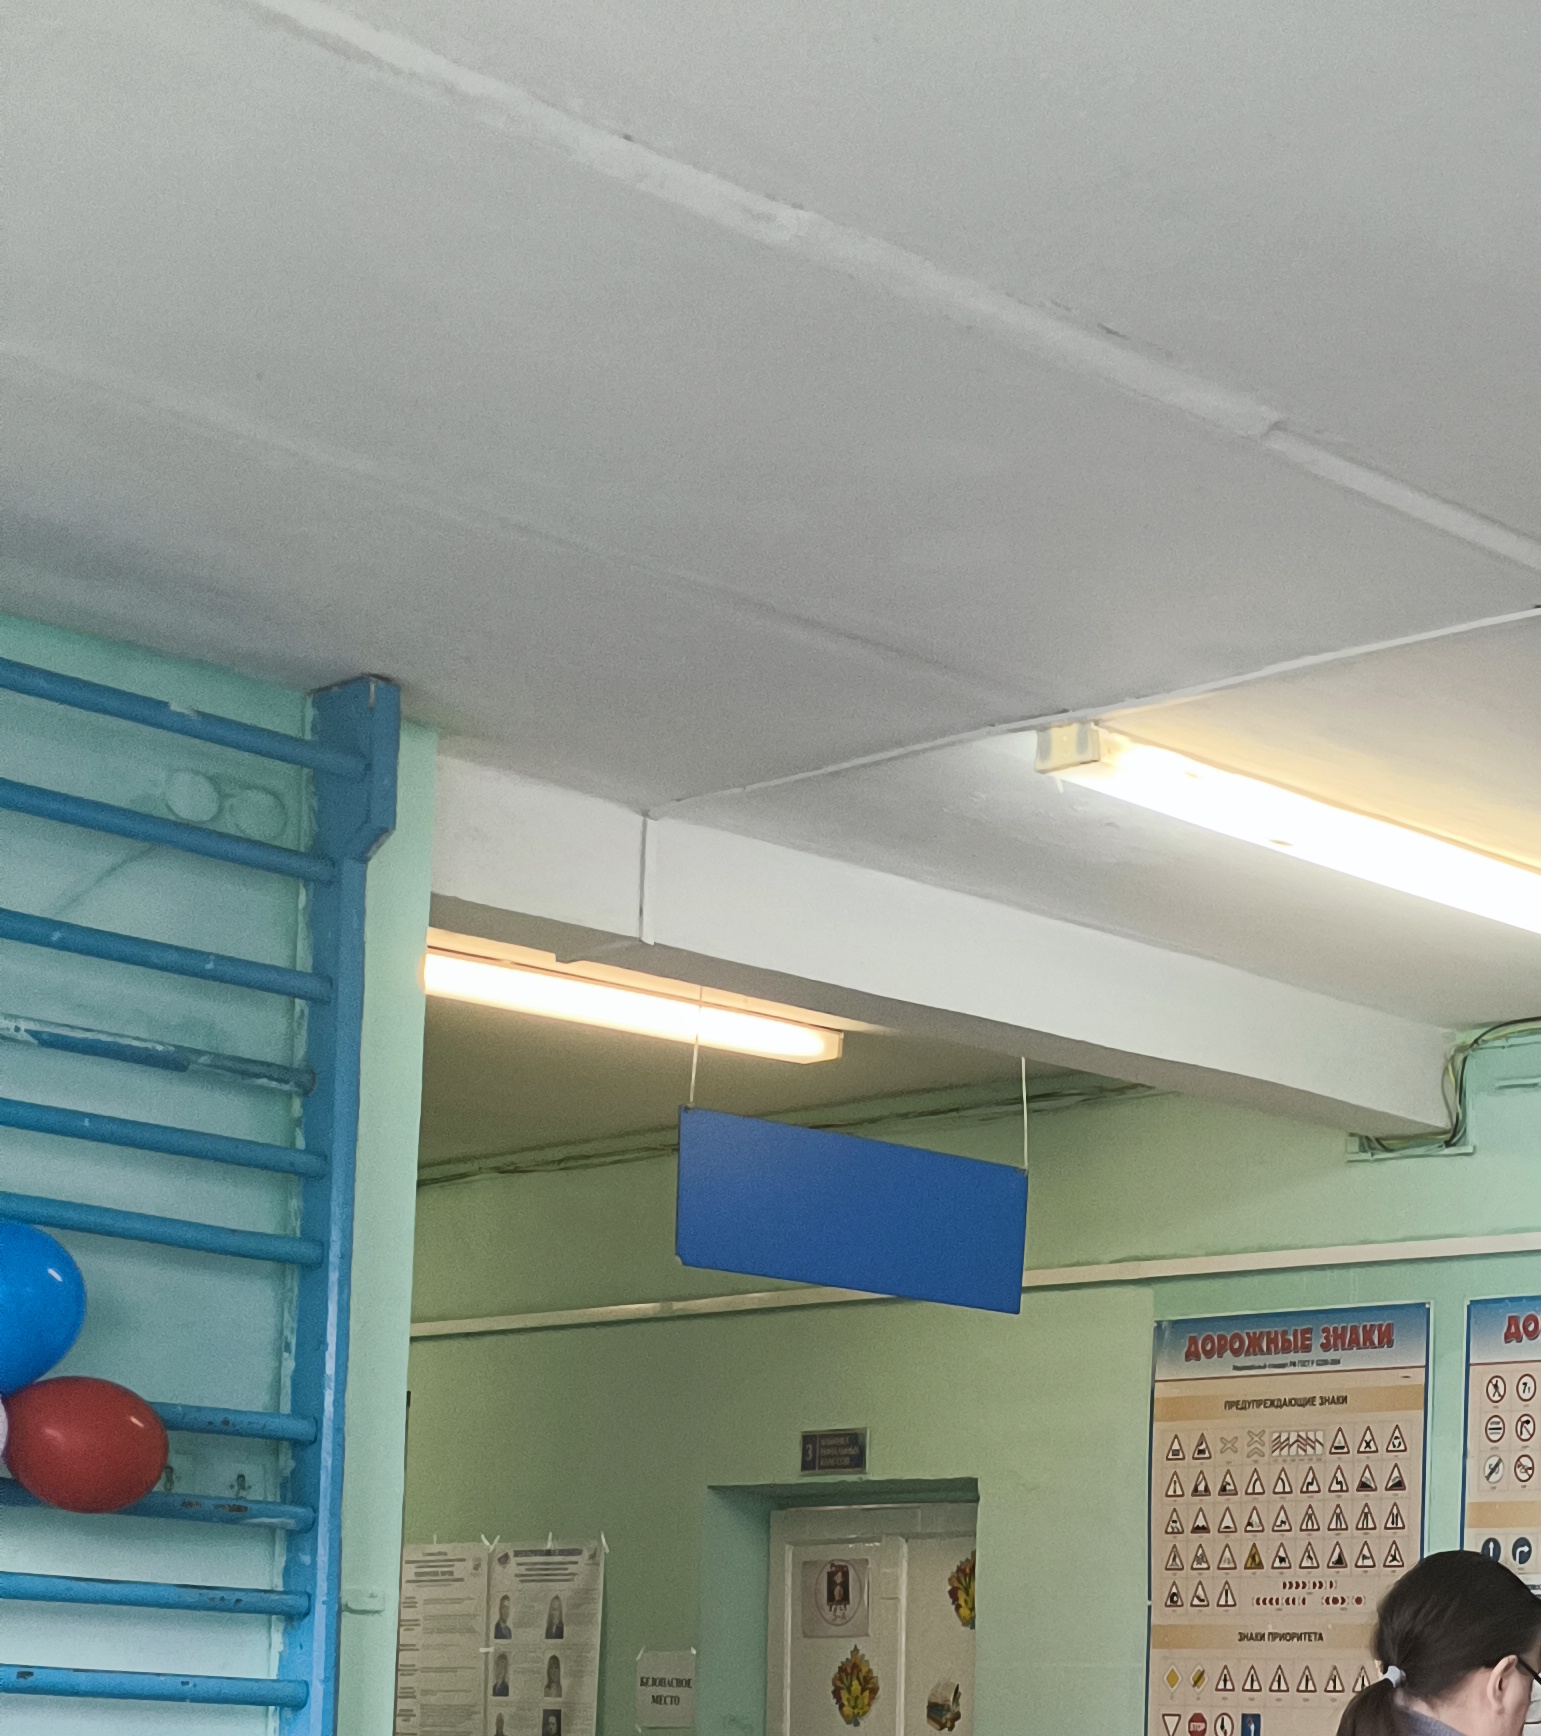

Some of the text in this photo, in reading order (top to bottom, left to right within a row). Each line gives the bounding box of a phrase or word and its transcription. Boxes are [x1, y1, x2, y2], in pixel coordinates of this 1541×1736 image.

[1184, 1322, 1395, 1362] ДОРОЖНЫЕ ЗНАКИ
[1224, 1394, 1348, 1411] ПРЕДУПРЕЖДАЮЩИЕ ЗНАКИ
[1237, 1631, 1324, 1643] ЗНАКИ ПРИОРИТЕТА
[651, 1694, 680, 1706] МЕСТО
